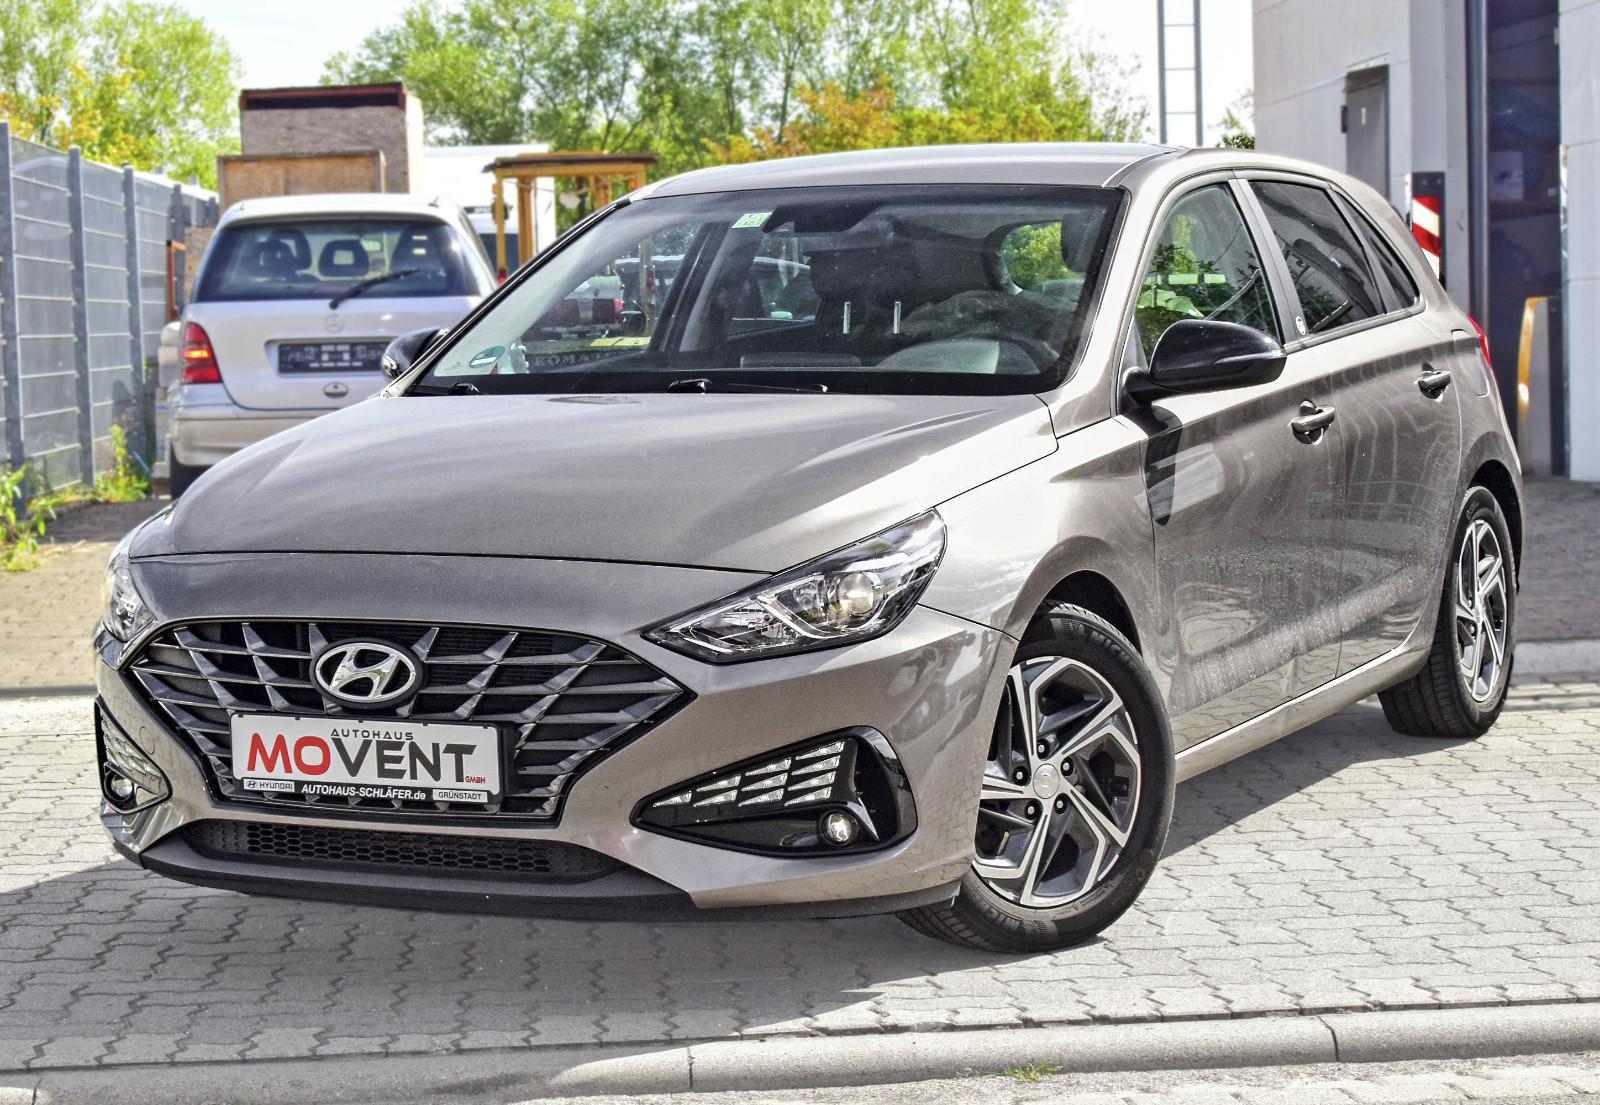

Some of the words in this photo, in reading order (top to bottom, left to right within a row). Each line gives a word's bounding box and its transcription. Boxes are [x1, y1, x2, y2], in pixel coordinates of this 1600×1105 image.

[330, 728, 414, 741] AUTOHAUS
[247, 732, 477, 783] MOVENT
[259, 781, 293, 791] HYUNDAI
[301, 783, 426, 800] AUTOHAUS-SCHLÄFER.de
[438, 791, 482, 801] GRÜNSTADT
